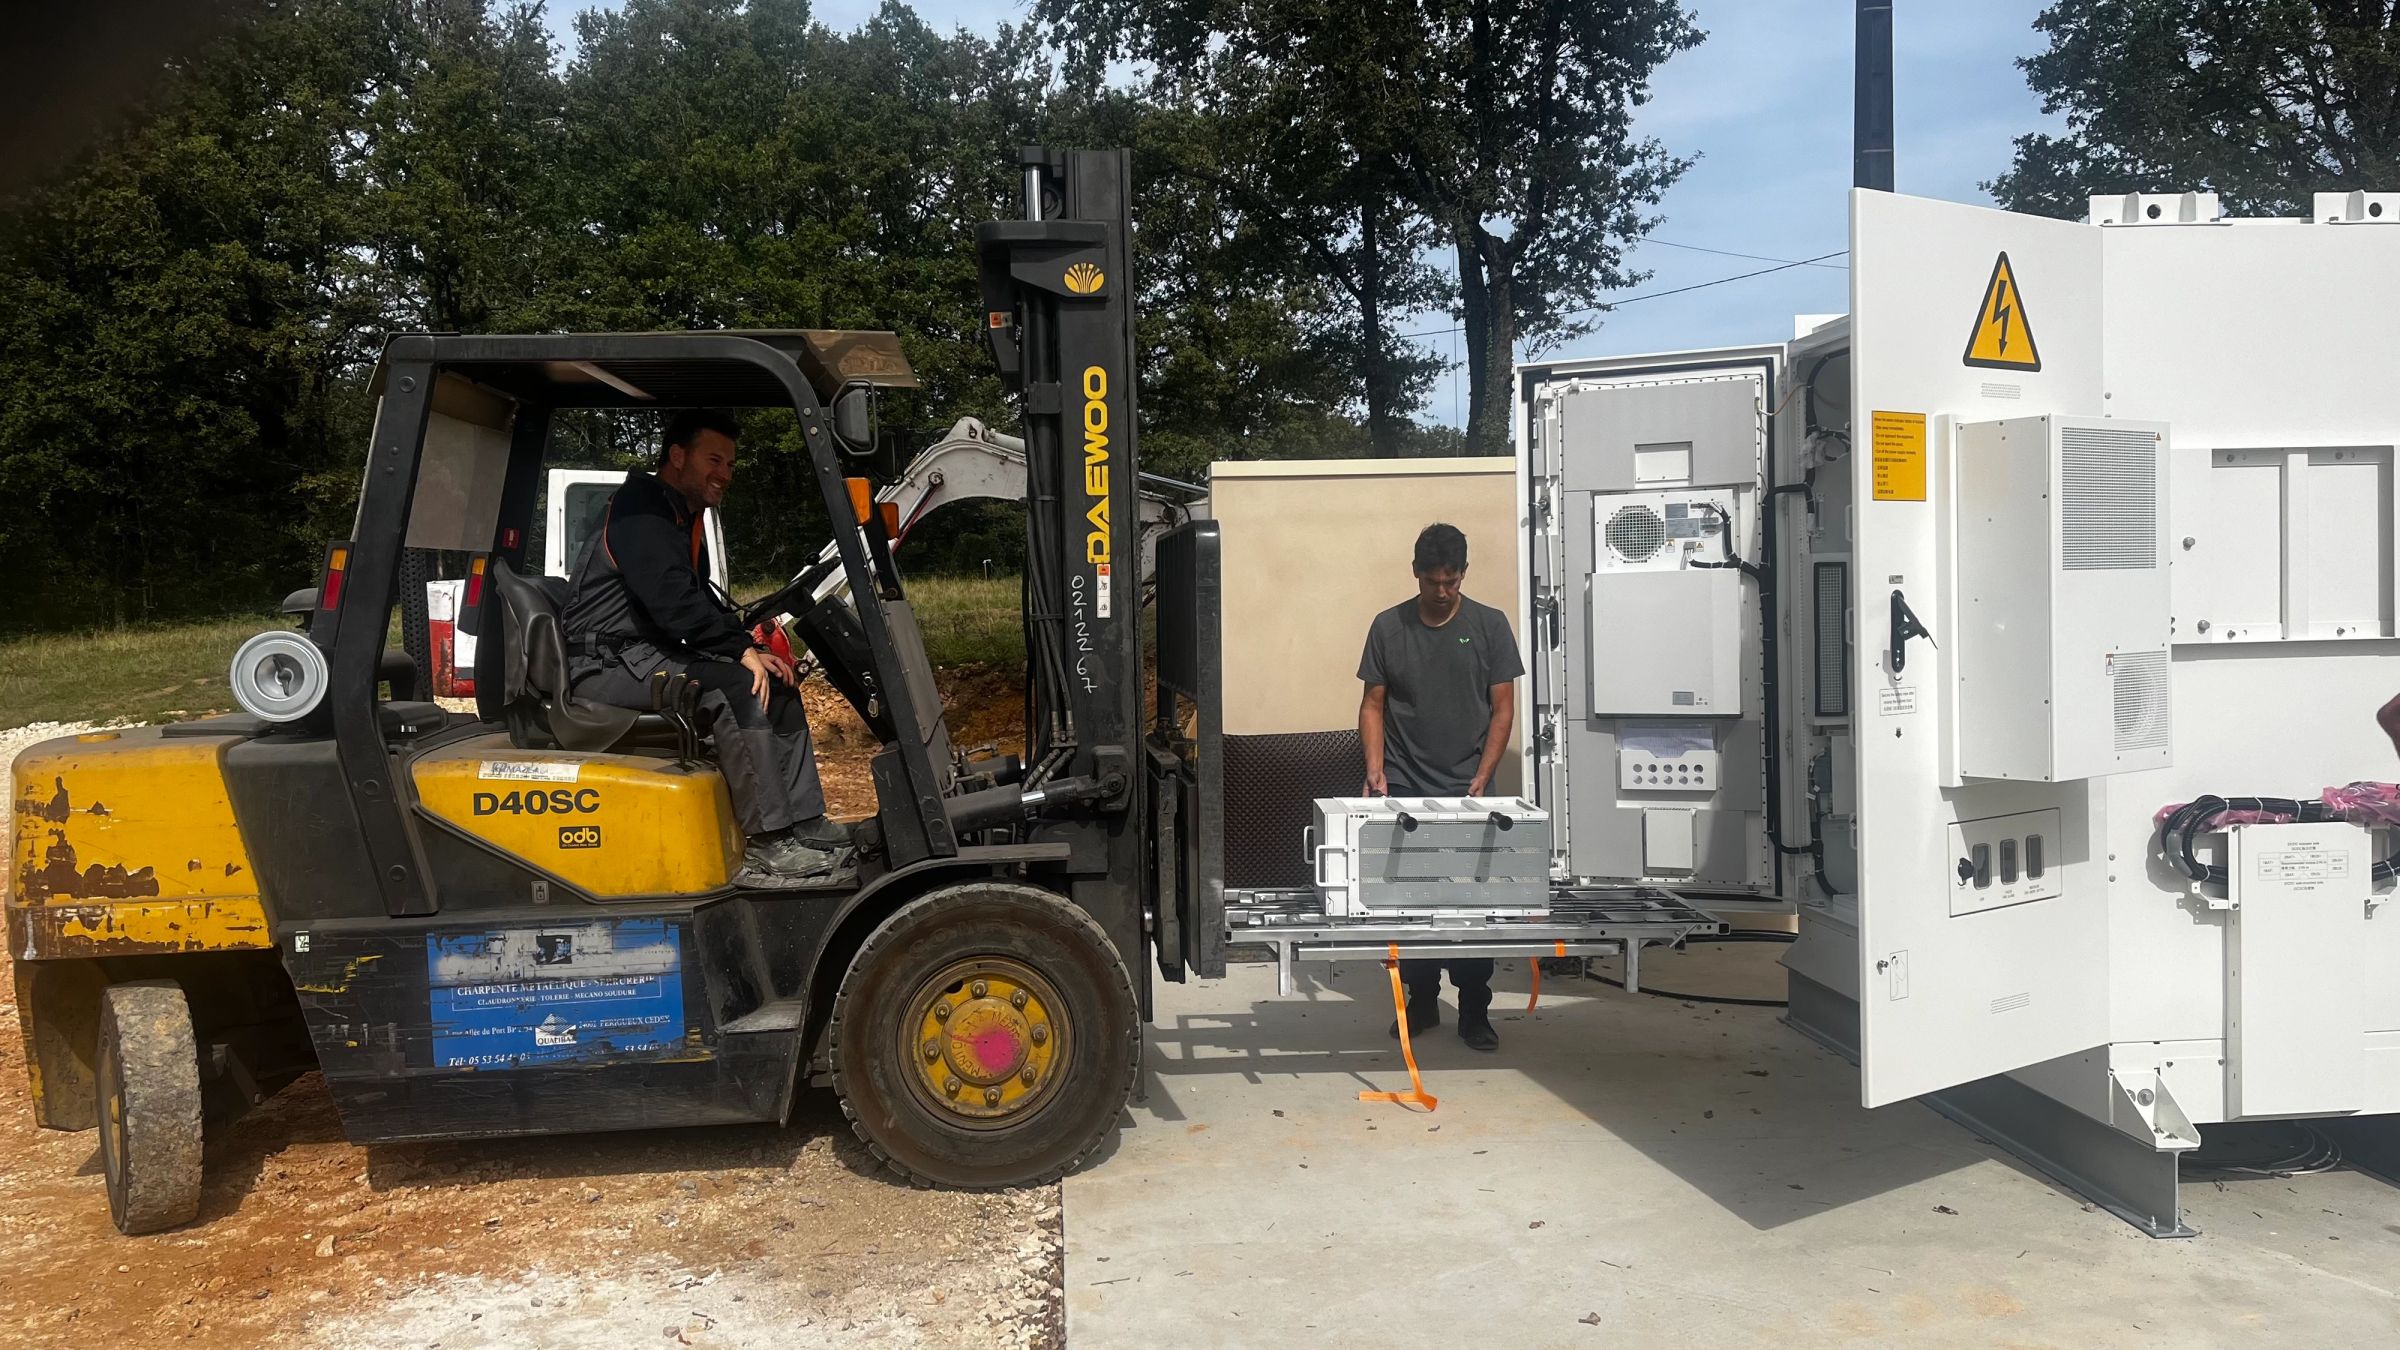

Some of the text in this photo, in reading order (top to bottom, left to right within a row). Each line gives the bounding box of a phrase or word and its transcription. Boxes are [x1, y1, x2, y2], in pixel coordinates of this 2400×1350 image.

[1082, 365, 1110, 565] DAEWOO
[473, 788, 600, 816] D40SC
[561, 827, 599, 844] odb
[457, 983, 518, 996] CHARPENTE
[468, 1055, 479, 1065] 05
[481, 1055, 492, 1065] 53
